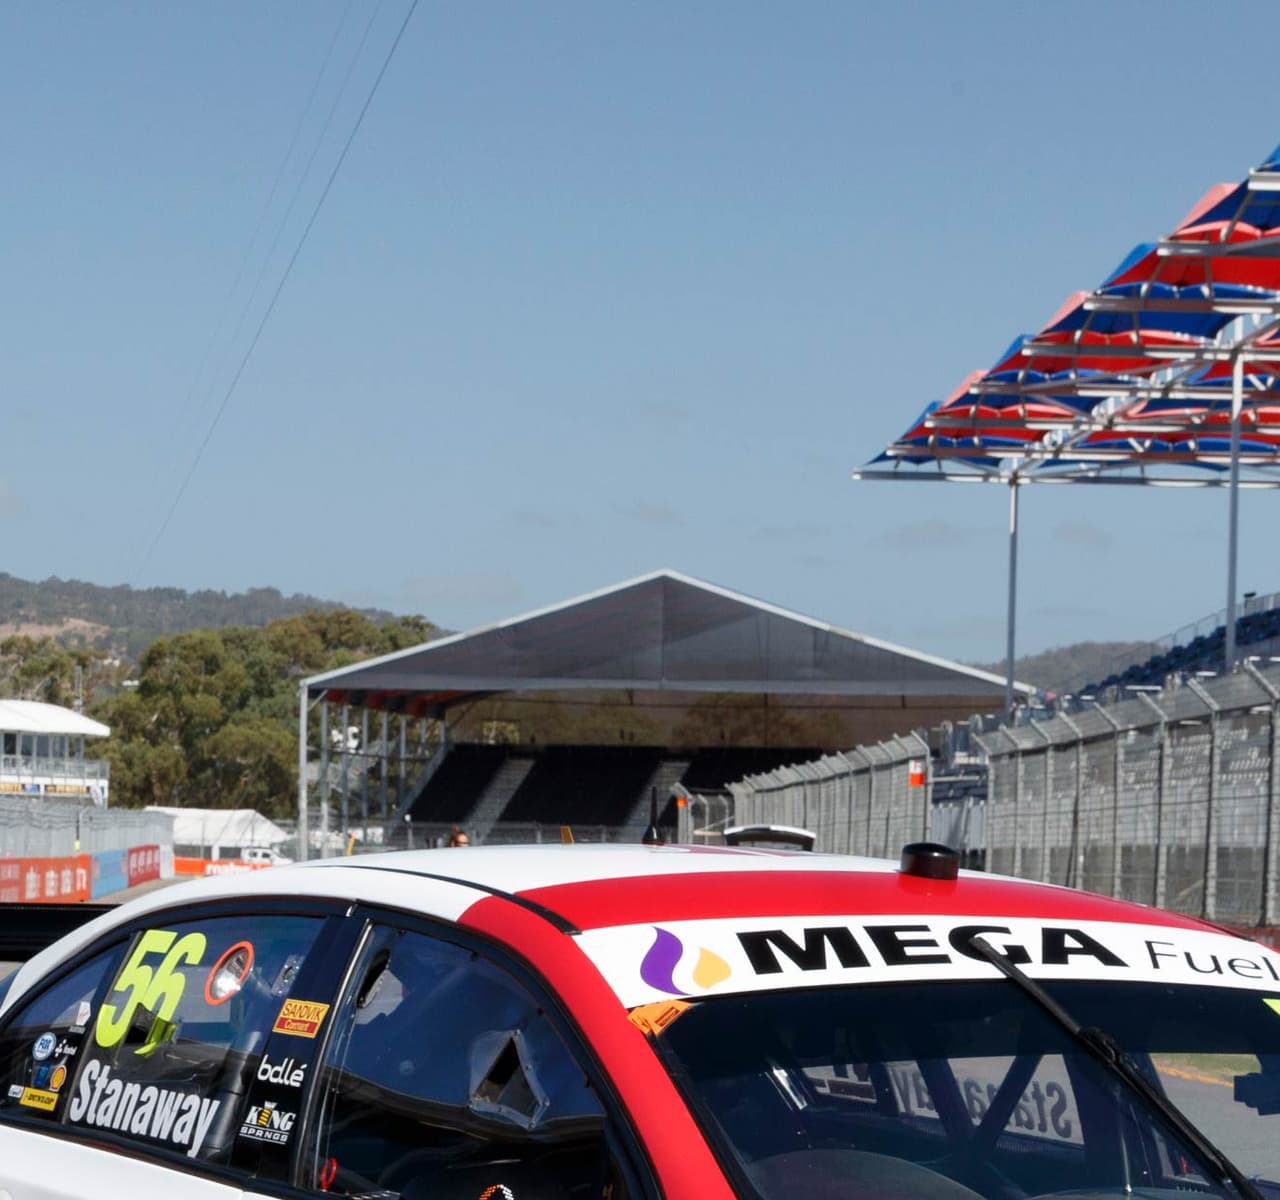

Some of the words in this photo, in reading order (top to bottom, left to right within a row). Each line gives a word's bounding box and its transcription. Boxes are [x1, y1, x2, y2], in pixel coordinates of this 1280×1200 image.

[736, 924, 1130, 975] MEGA
[96, 930, 206, 1055] 56
[283, 1003, 325, 1021] SANDVIK
[70, 1059, 220, 1158] Stanaway
